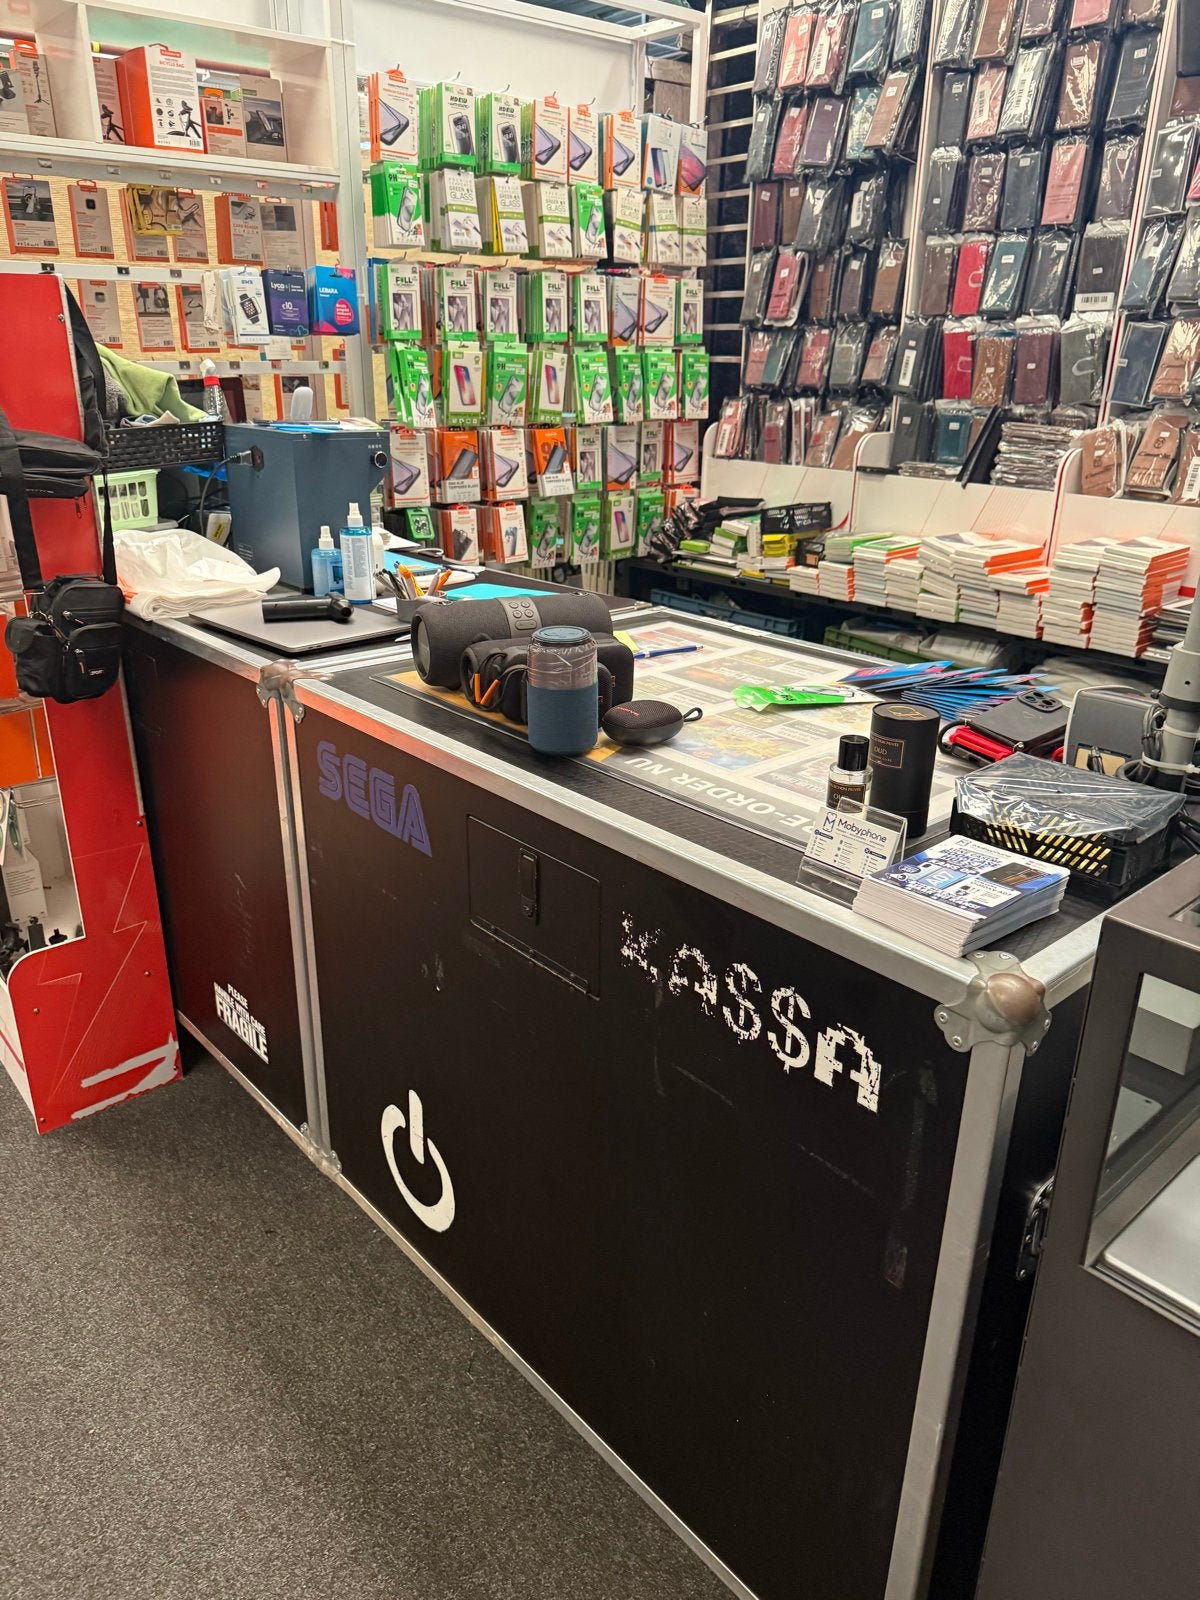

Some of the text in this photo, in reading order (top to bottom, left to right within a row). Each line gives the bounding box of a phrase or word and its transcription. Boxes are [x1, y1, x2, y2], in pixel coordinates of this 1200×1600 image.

[450, 192, 474, 201] GLASS
[500, 199, 520, 208] GLASS
[546, 204, 566, 213] GLASS
[620, 208, 639, 220] GLASS
[874, 746, 888, 755] OUD
[624, 757, 672, 776] NU
[317, 740, 432, 858] SEGA
[838, 818, 887, 843] Mobyphone
[924, 870, 957, 886] A07
[227, 983, 248, 1009] PLEASE
[215, 992, 269, 1064] FRAGILE
